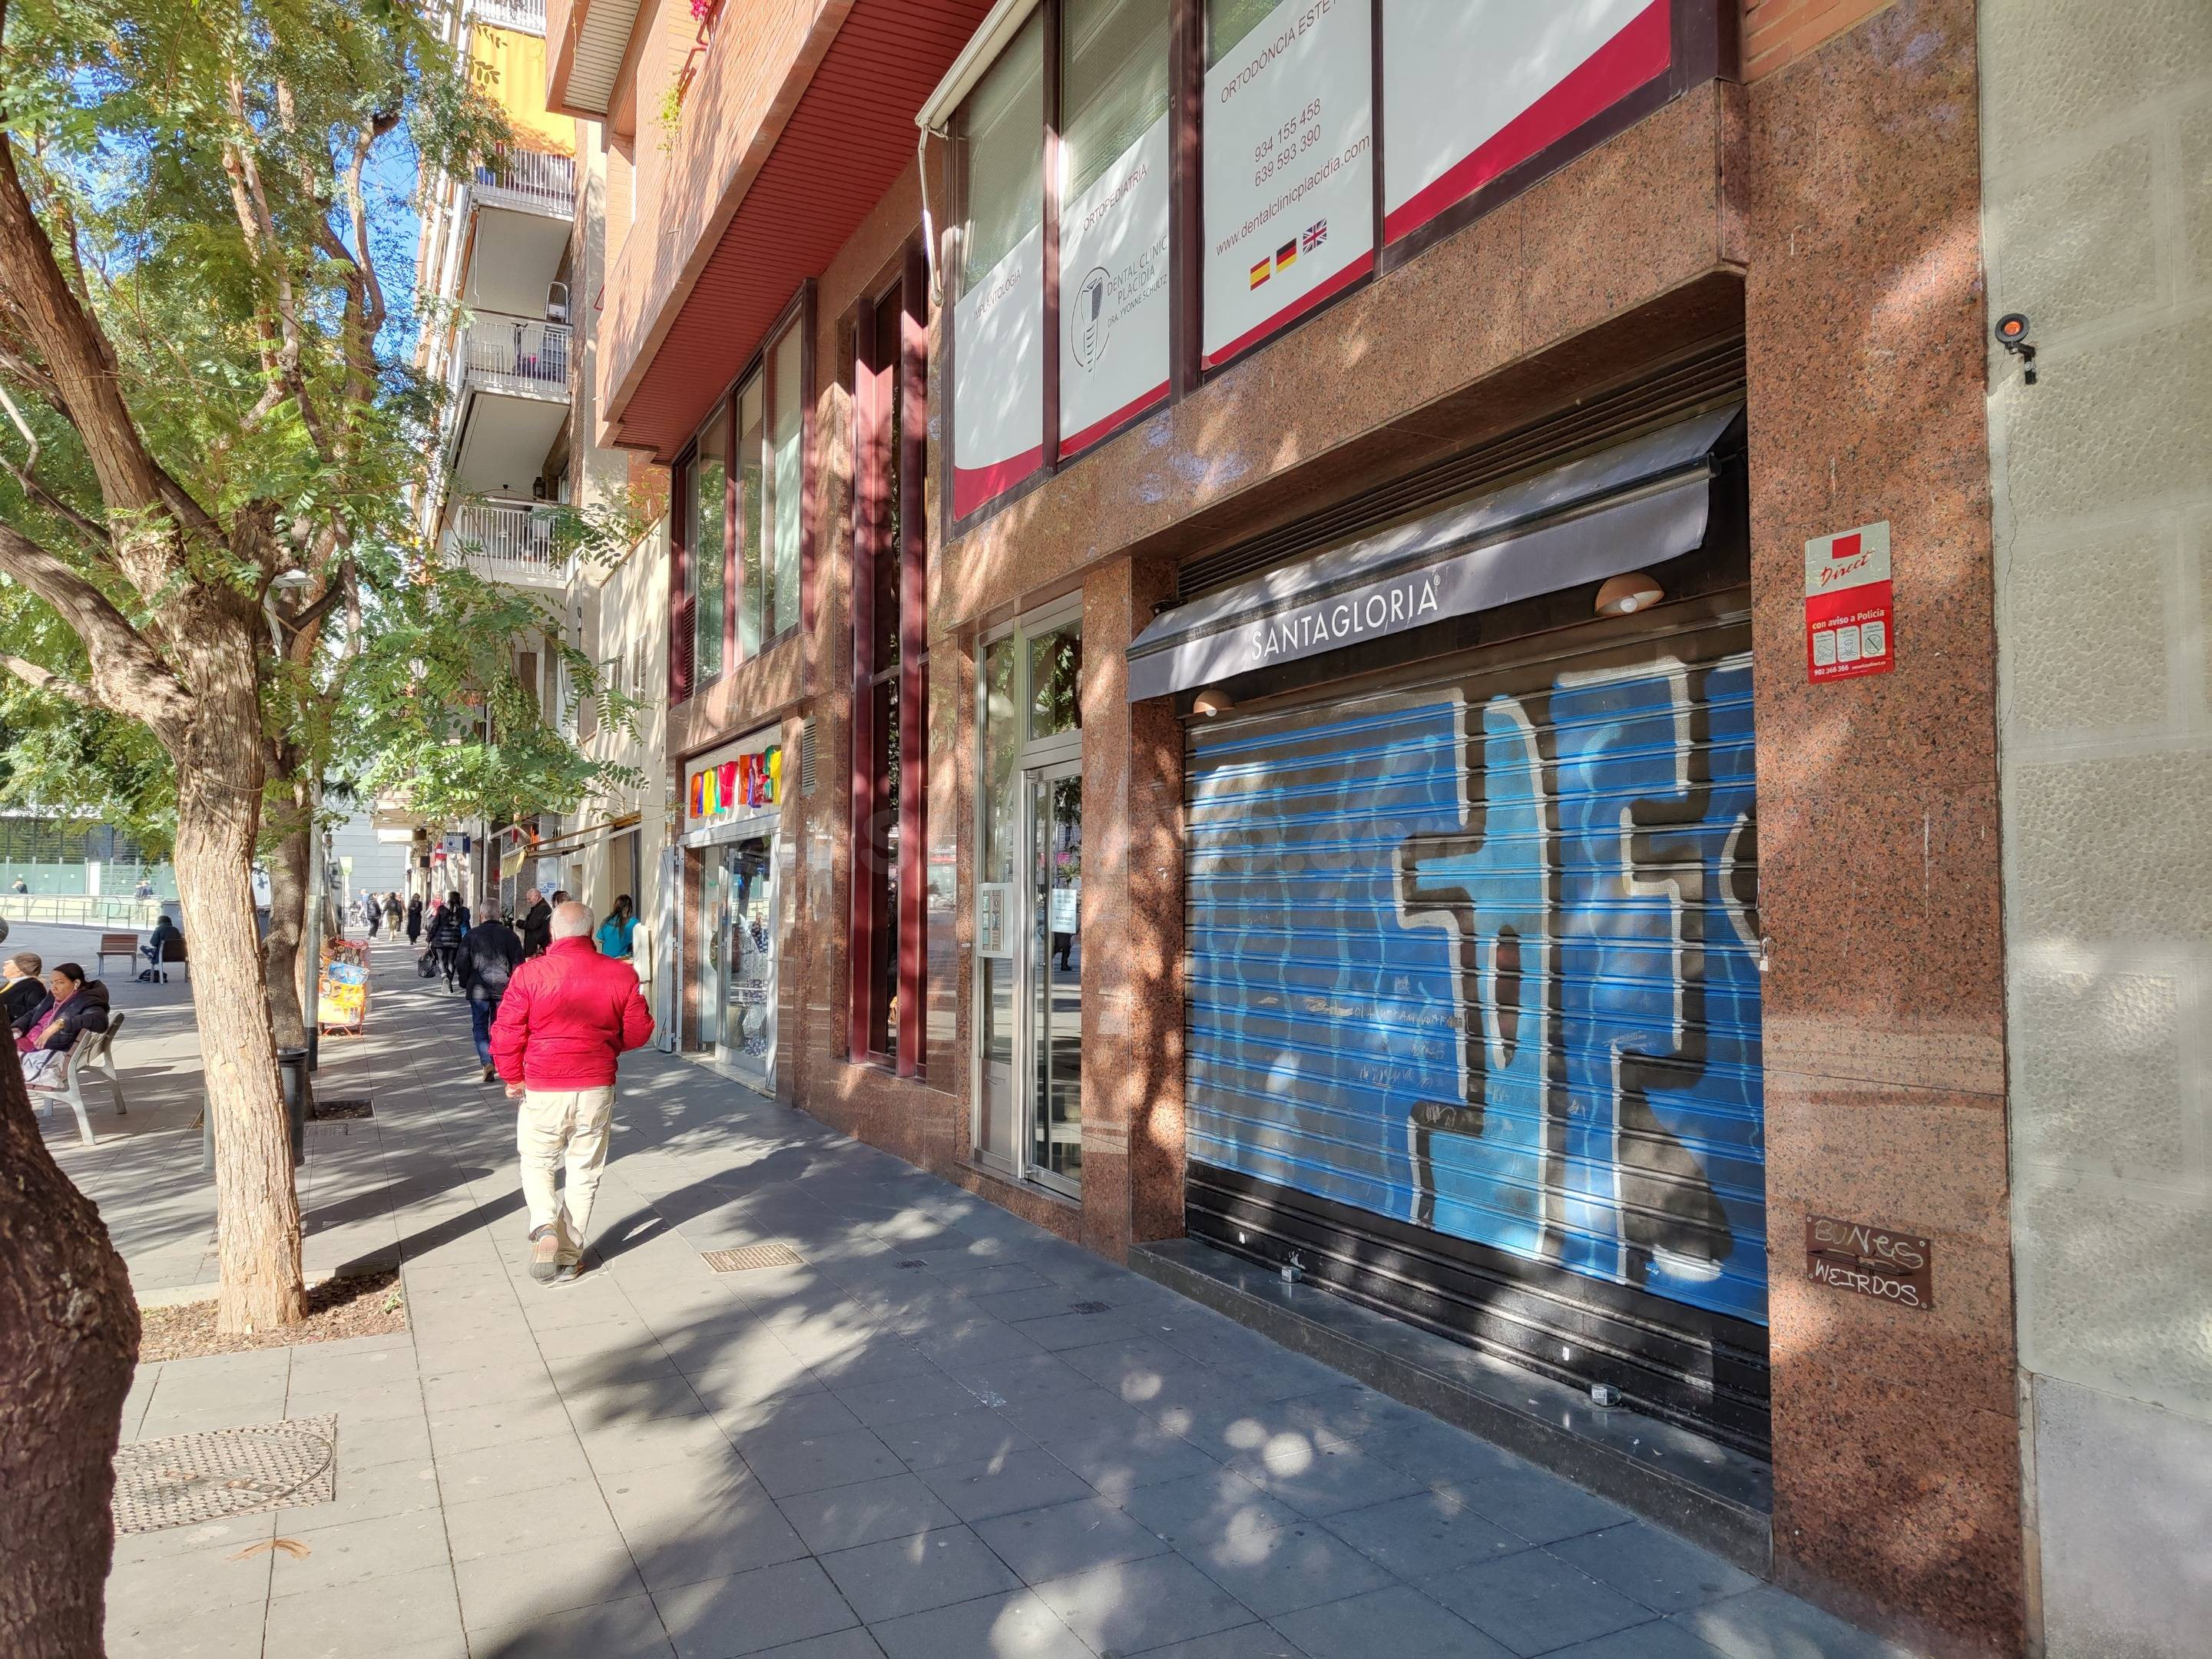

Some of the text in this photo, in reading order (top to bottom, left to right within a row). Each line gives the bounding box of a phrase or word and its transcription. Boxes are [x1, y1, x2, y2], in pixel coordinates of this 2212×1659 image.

[1299, 0, 1336, 35] ESTE
[1255, 98, 1321, 163] 934 155 458
[1255, 124, 1321, 187] 639 593 390
[1083, 164, 1147, 231] ORTOPEDIATRIA
[1216, 135, 1370, 257] www.dentalclinicplacidia.com
[1107, 235, 1167, 296] DENTAL CLINIC
[1107, 273, 1167, 328] DRA. YVONNE SCHULTZ
[1812, 621, 1826, 630] con
[1827, 616, 1849, 628] aviso
[1856, 608, 1885, 621] Policía
[1813, 667, 1826, 676] 902
[1815, 1259, 1919, 1306] WEIRDOS
